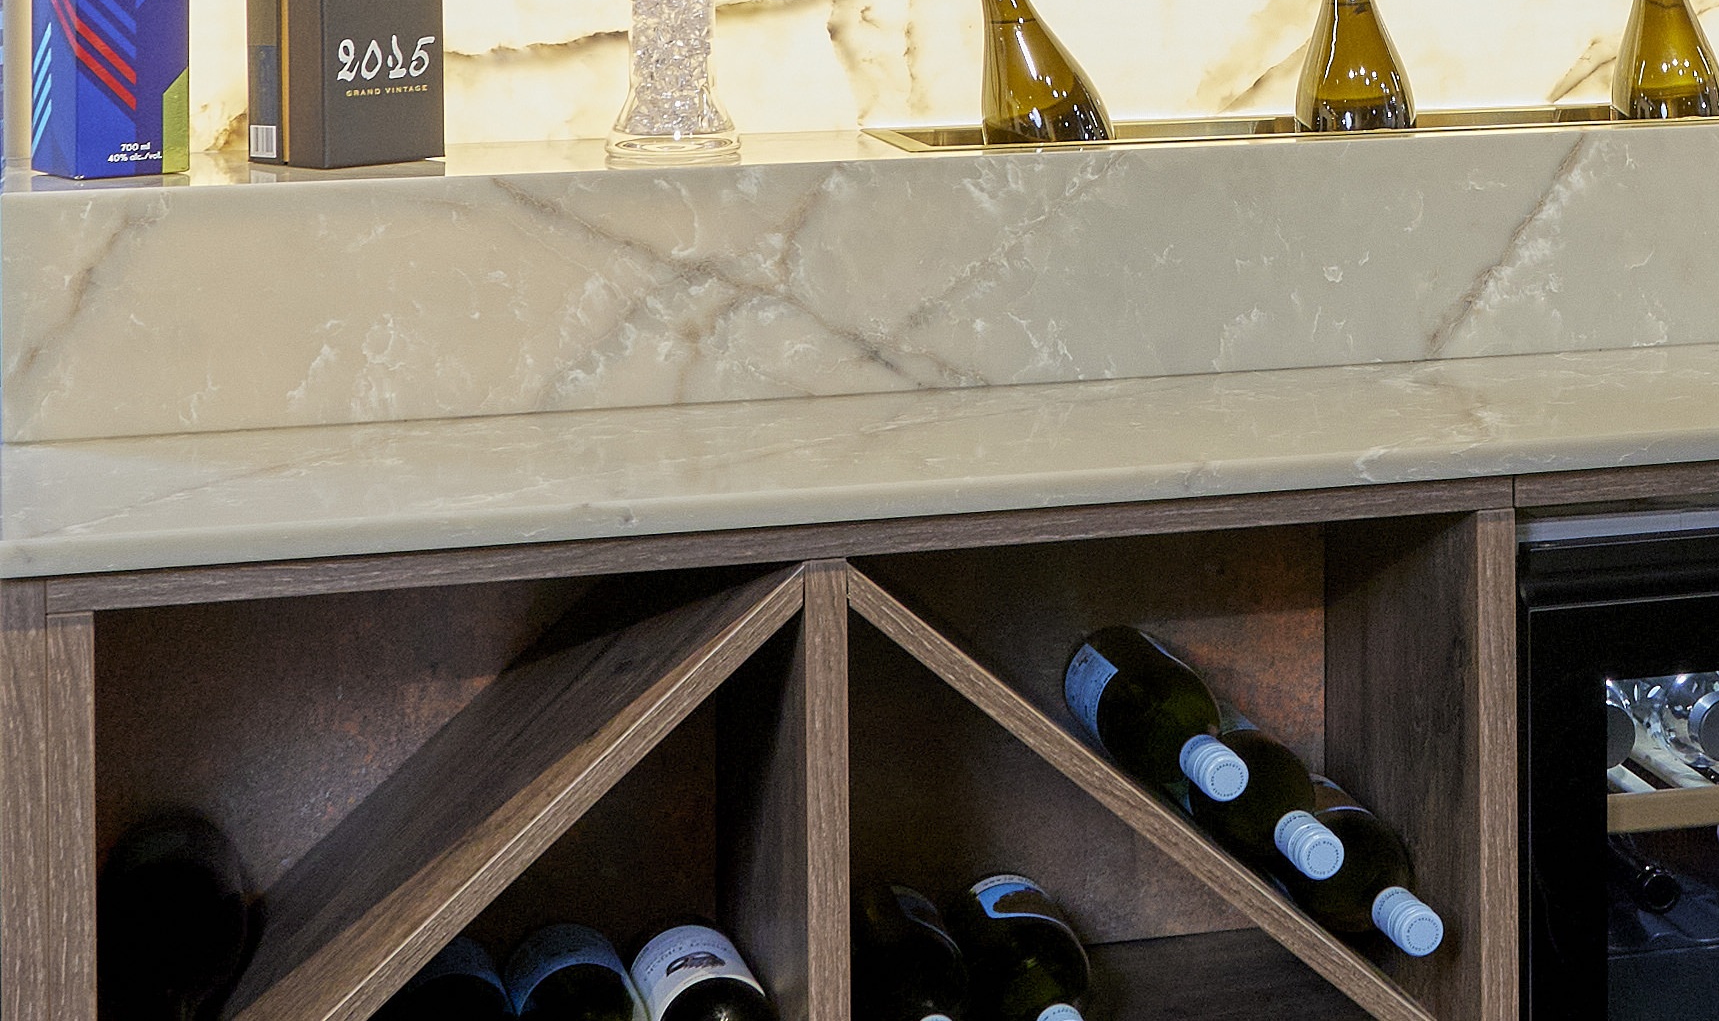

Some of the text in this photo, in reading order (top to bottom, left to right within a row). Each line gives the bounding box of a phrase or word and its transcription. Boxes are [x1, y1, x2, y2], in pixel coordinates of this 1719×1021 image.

[336, 34, 436, 82] 2015
[345, 84, 429, 97] GRAND VINTAGE
[120, 143, 140, 152] 700
